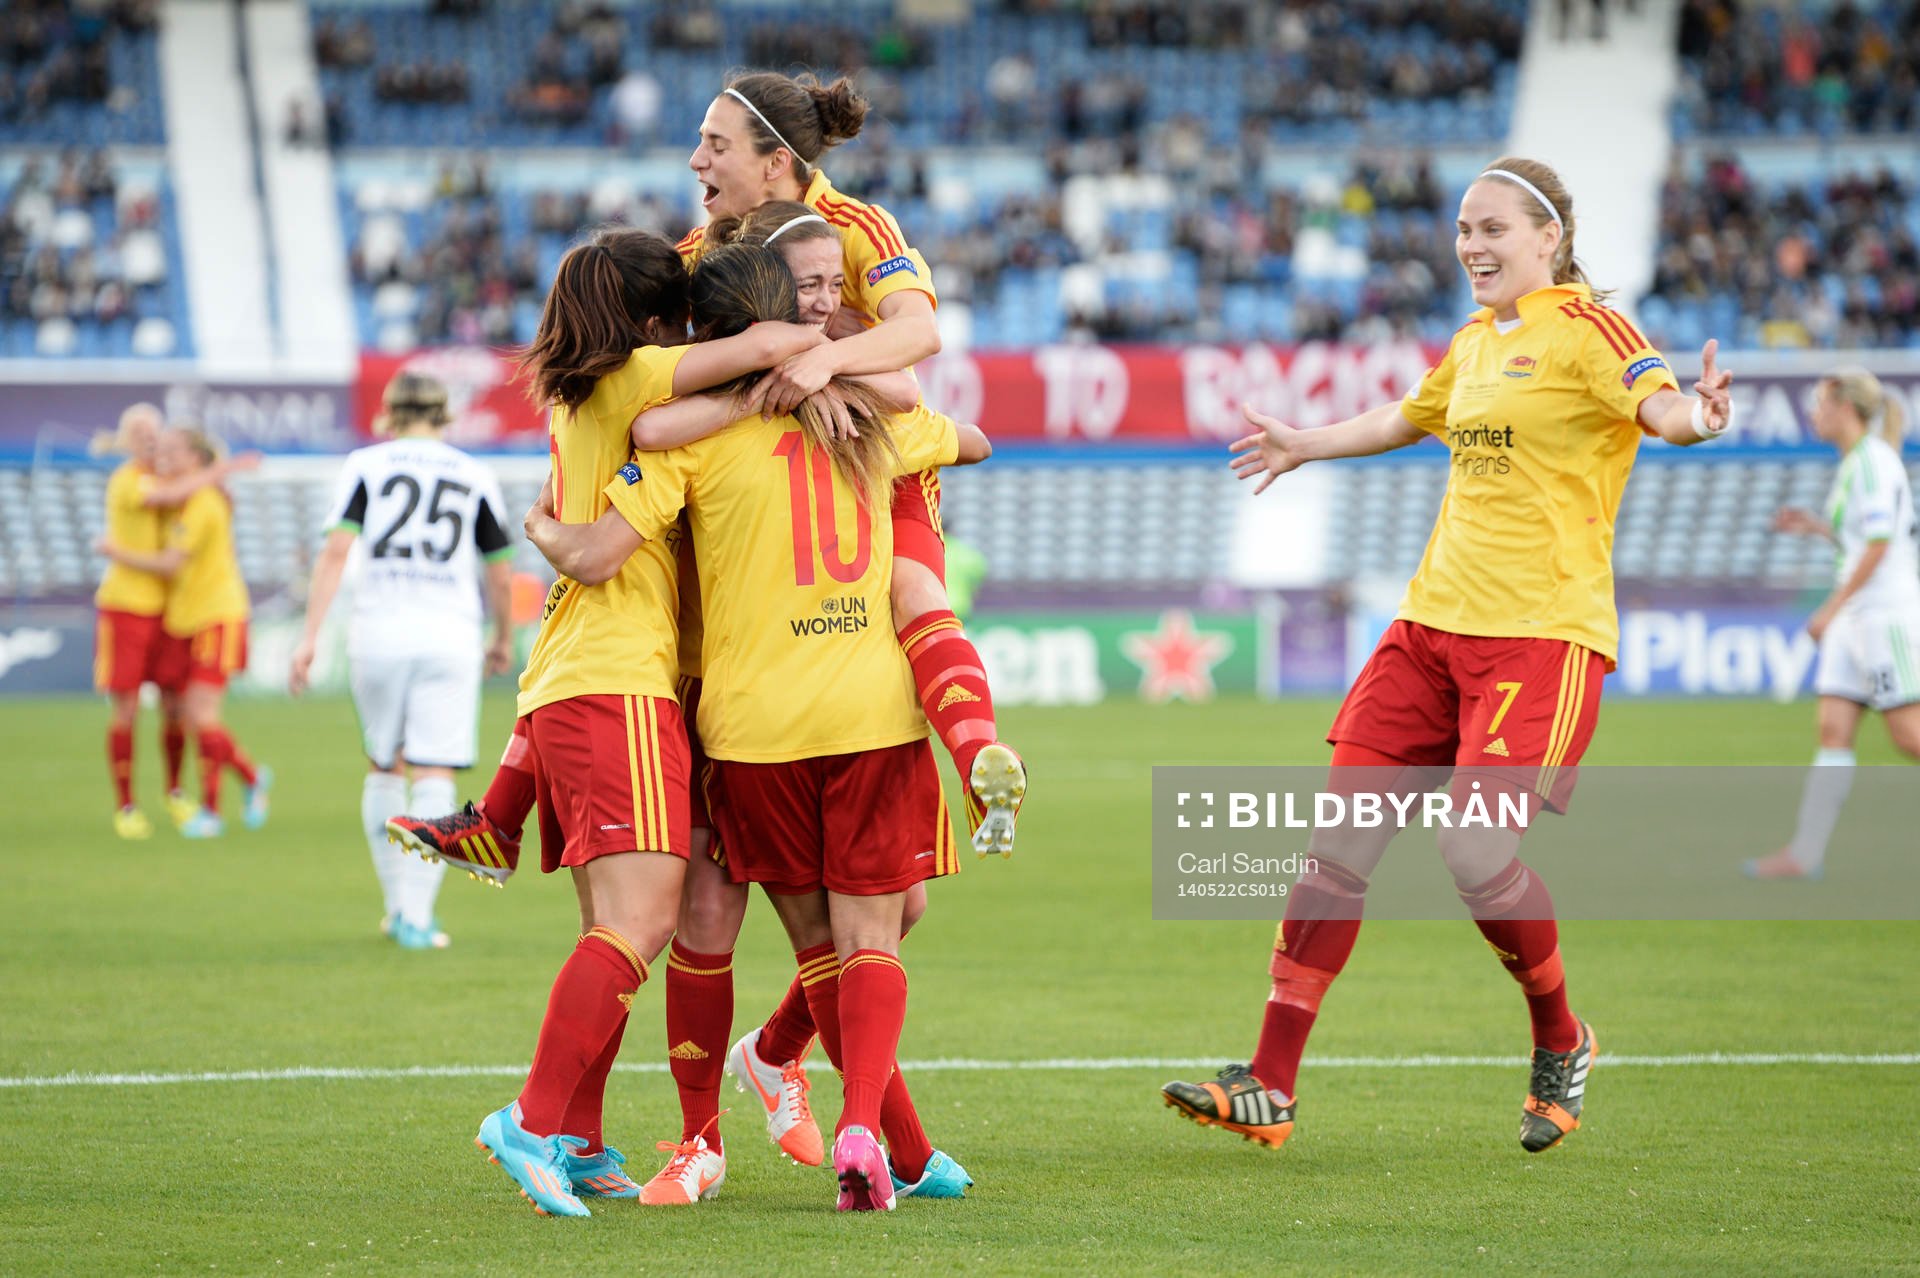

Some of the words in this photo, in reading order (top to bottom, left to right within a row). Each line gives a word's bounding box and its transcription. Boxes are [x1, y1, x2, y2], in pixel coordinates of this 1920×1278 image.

[1033, 344, 1130, 442] TO
[372, 474, 472, 563] 25
[771, 430, 872, 587] 10
[790, 616, 868, 636] WOMEN
[841, 597, 866, 614] UN
[1622, 609, 1816, 705] Play
[1487, 682, 1523, 735] 7
